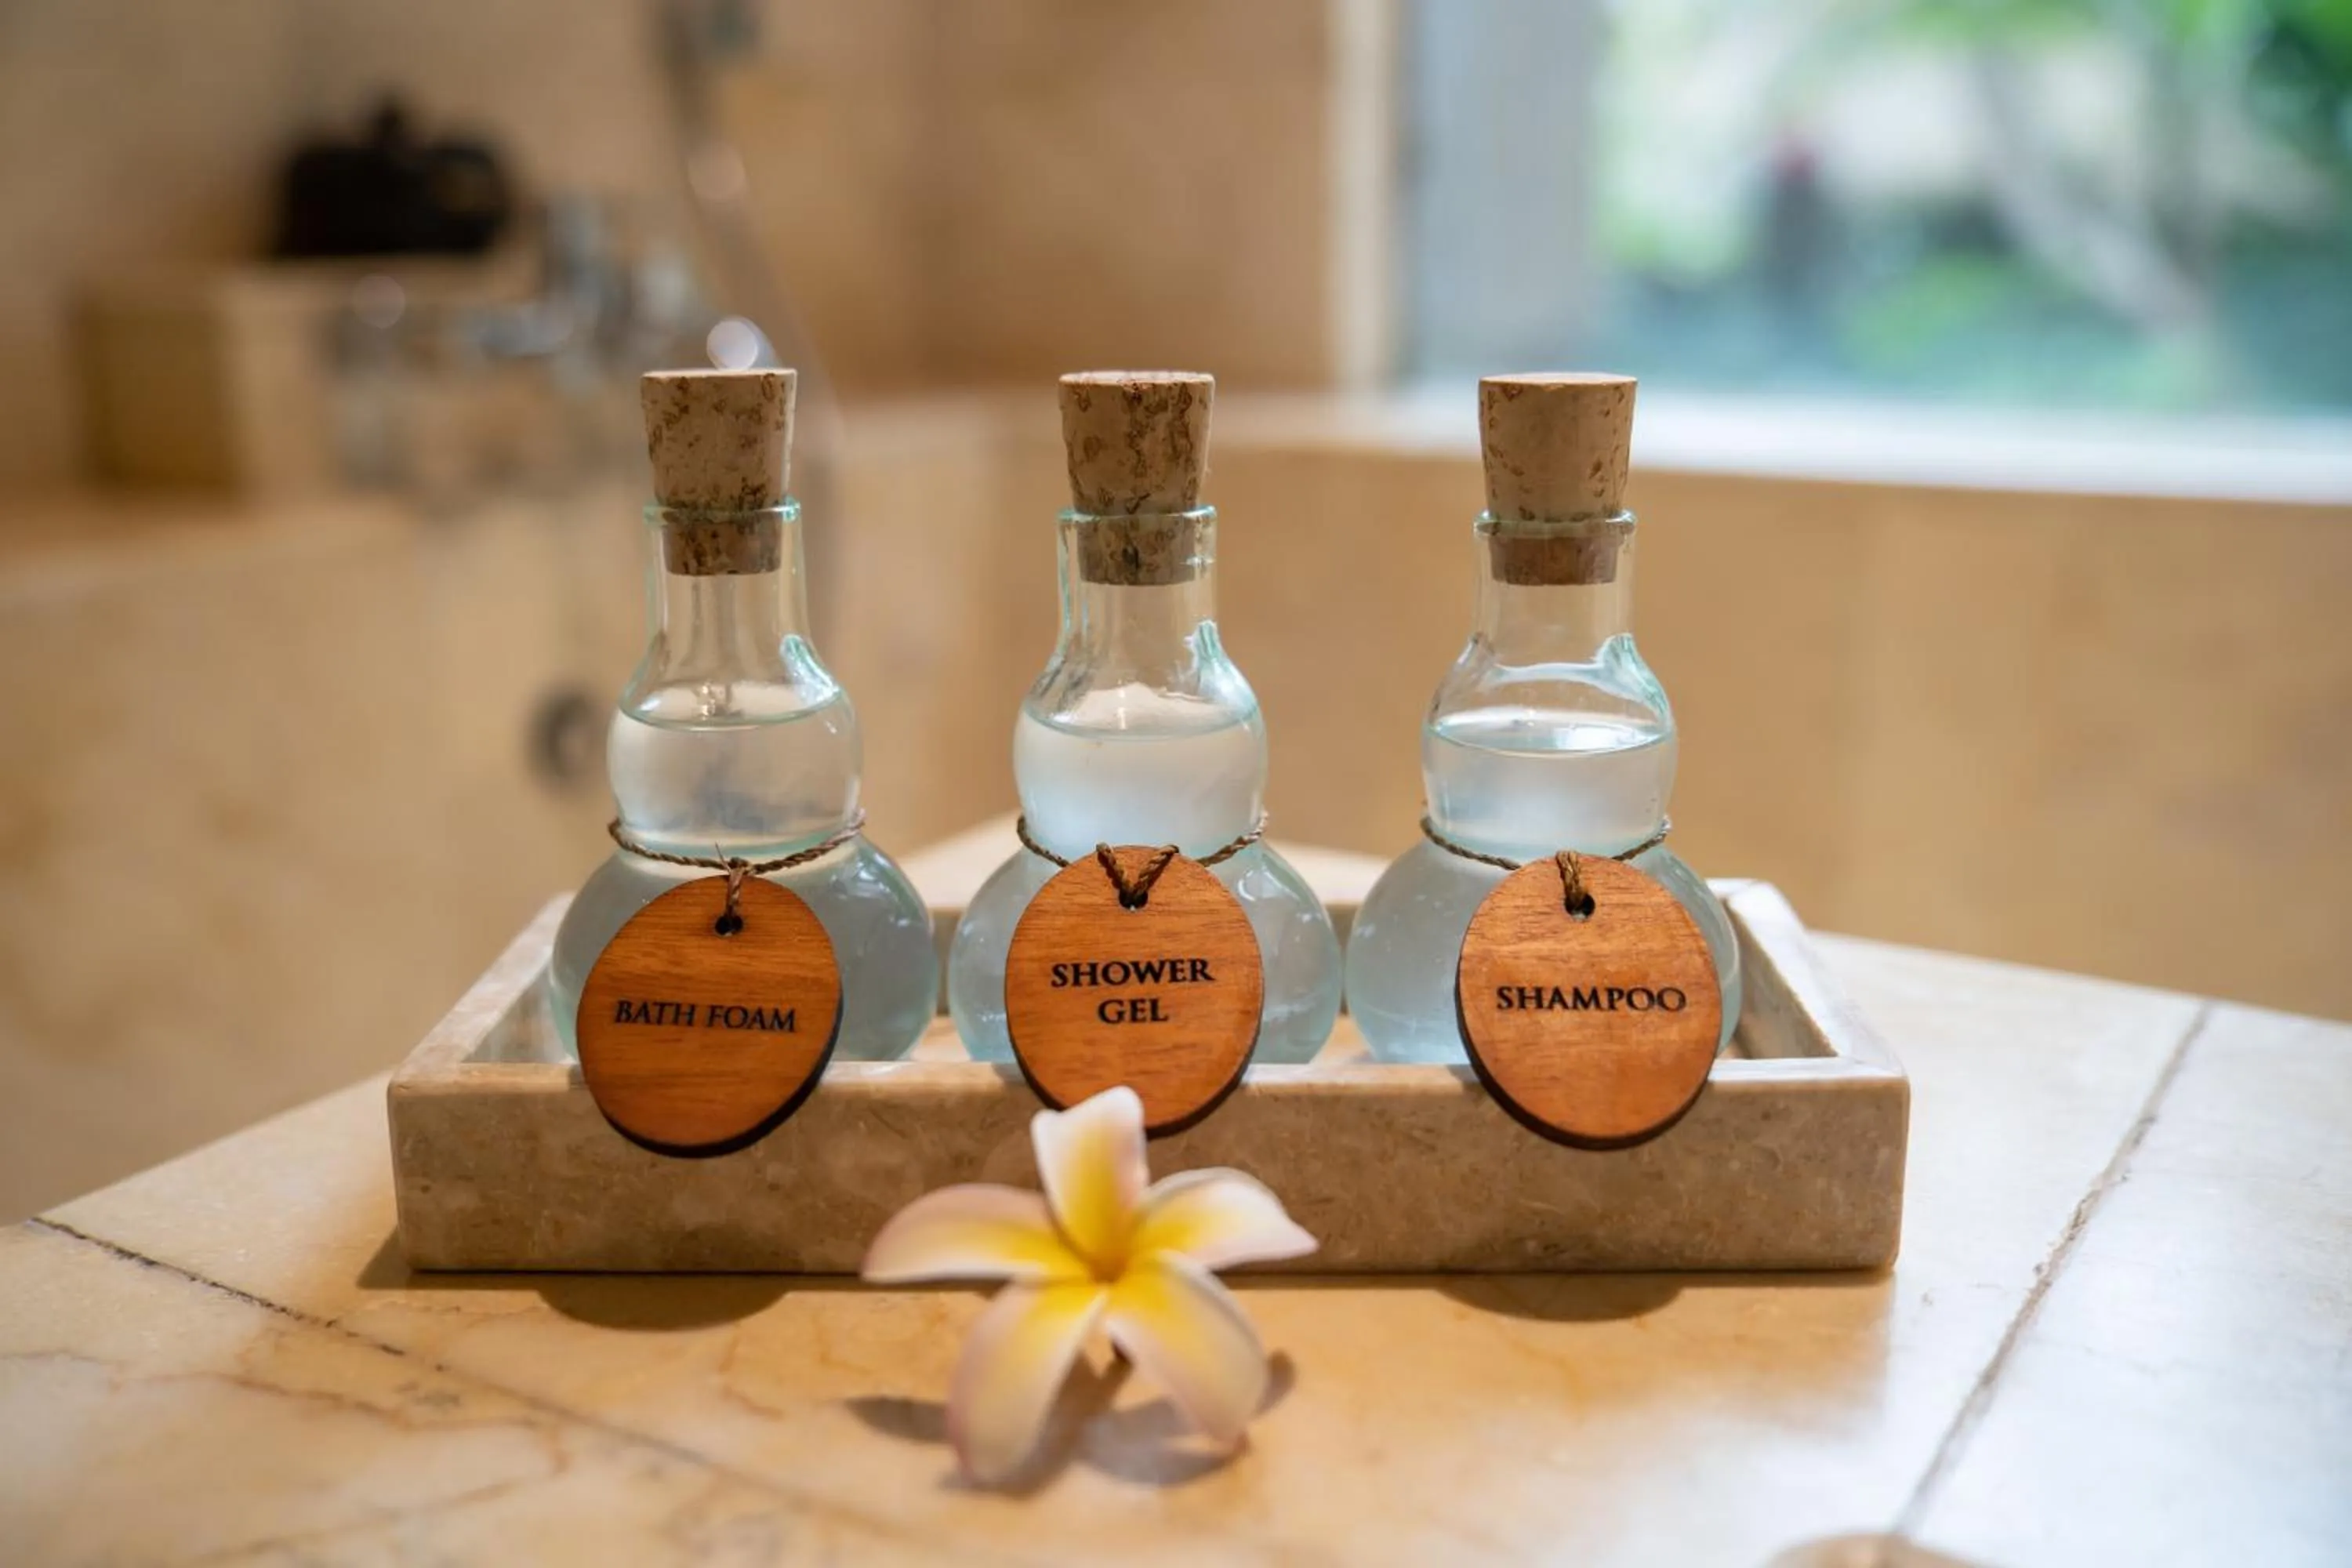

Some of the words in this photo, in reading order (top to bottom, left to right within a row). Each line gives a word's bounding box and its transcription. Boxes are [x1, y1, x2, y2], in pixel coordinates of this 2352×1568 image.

[1051, 958, 1216, 989] SHOWER
[1097, 997, 1169, 1025] GEL
[1496, 985, 1687, 1012] SHAMPOO
[615, 1000, 696, 1028] BATH
[707, 1004, 797, 1033] FOAM
